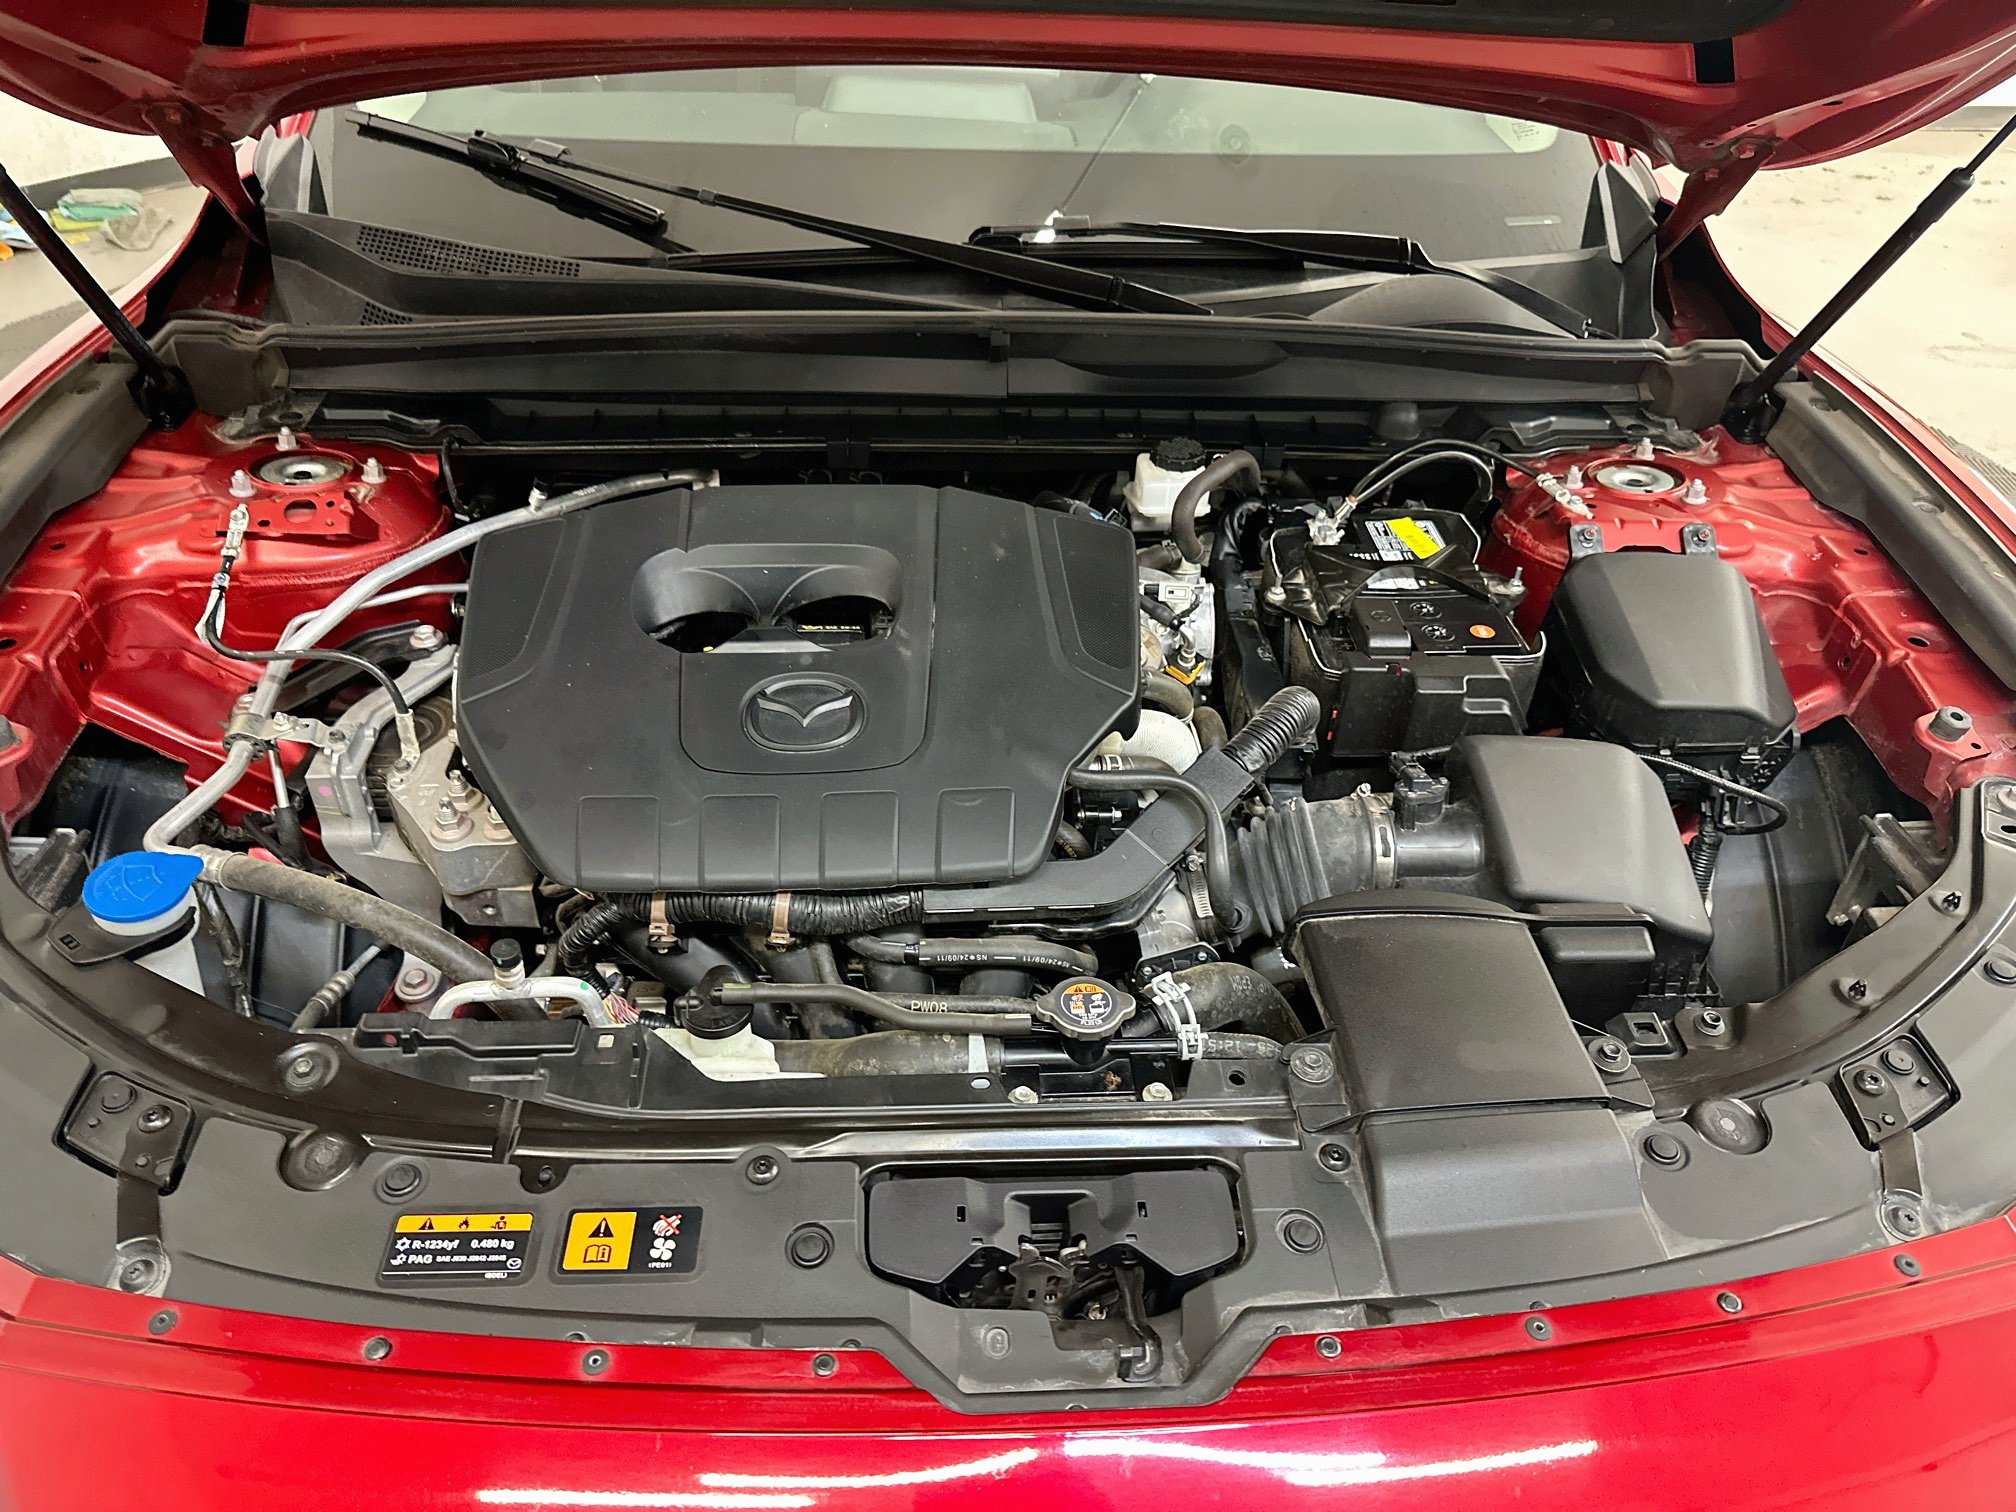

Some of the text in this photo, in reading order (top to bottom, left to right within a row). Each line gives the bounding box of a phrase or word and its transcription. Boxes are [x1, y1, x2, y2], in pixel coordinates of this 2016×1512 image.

[911, 1000, 948, 1013] PW08
[411, 1239, 515, 1251] R-1234yf 0.480 kg
[408, 1254, 433, 1264] PAG
